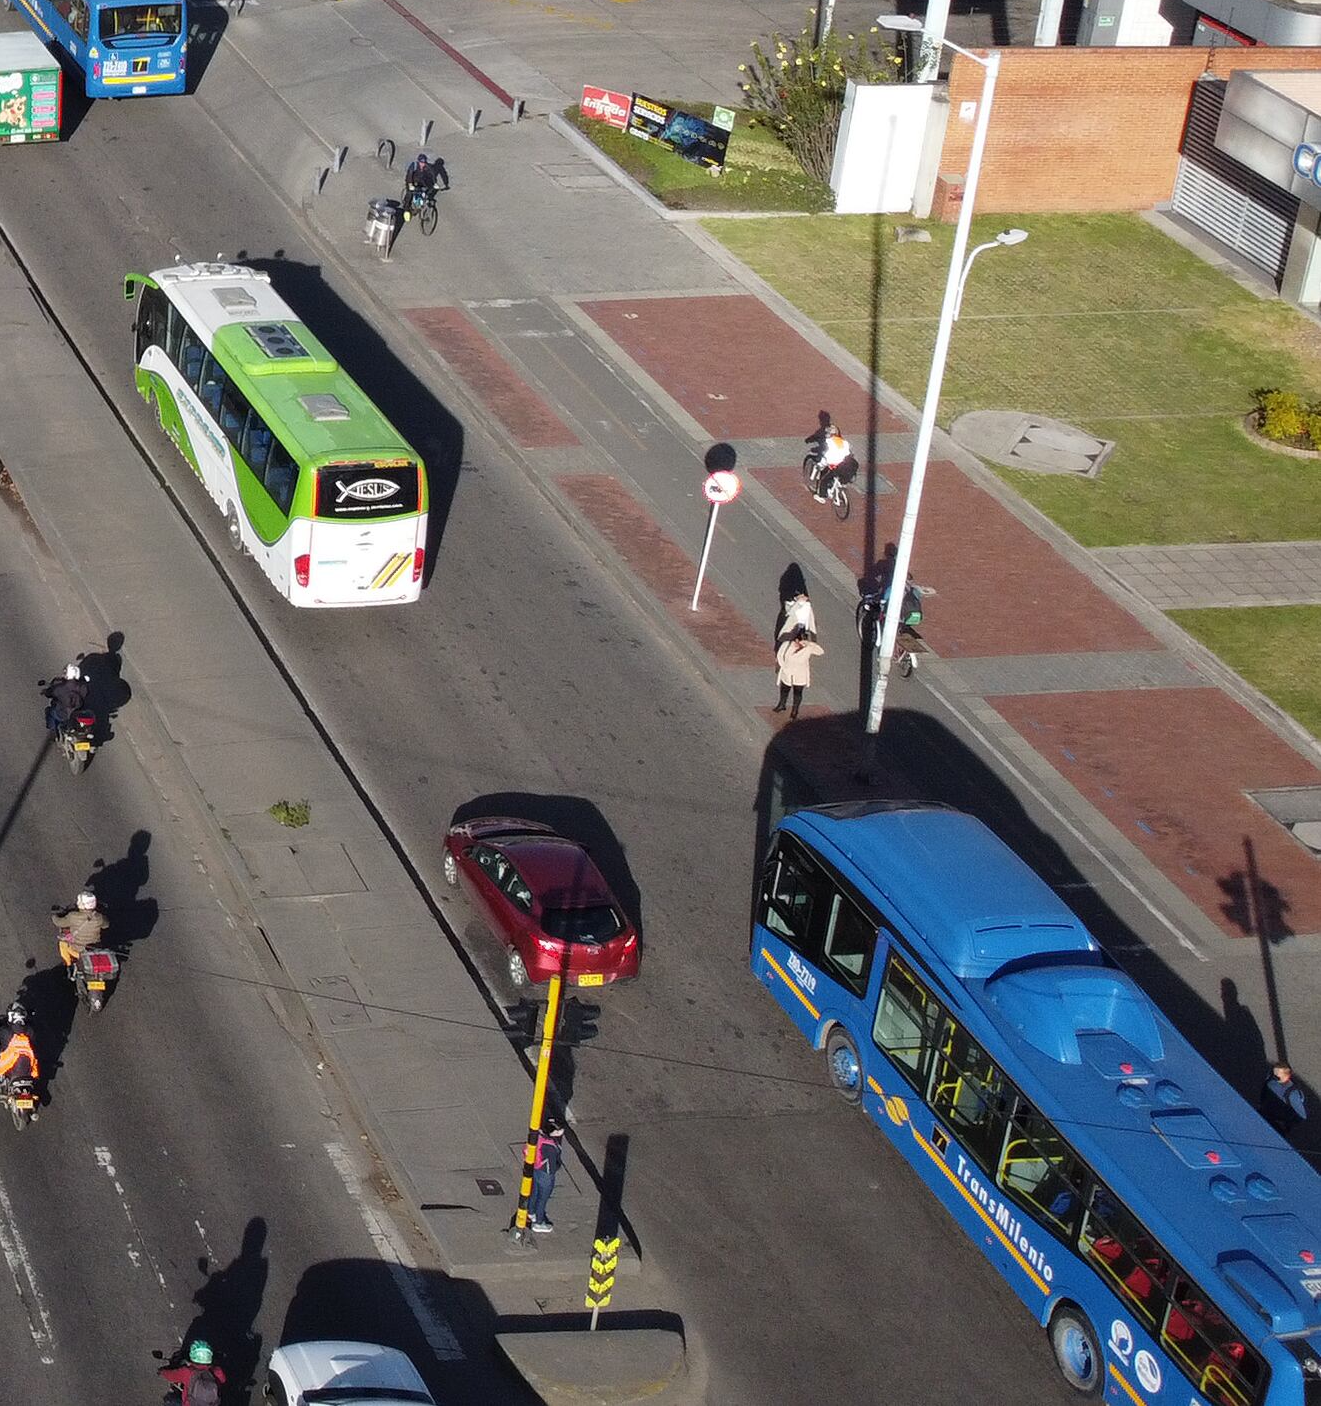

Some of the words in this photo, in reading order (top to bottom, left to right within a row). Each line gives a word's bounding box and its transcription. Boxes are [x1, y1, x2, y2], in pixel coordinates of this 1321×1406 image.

[583, 97, 627, 117] Entrada
[356, 483, 389, 496] JESUS
[957, 1154, 1053, 1281] TransMilenio
